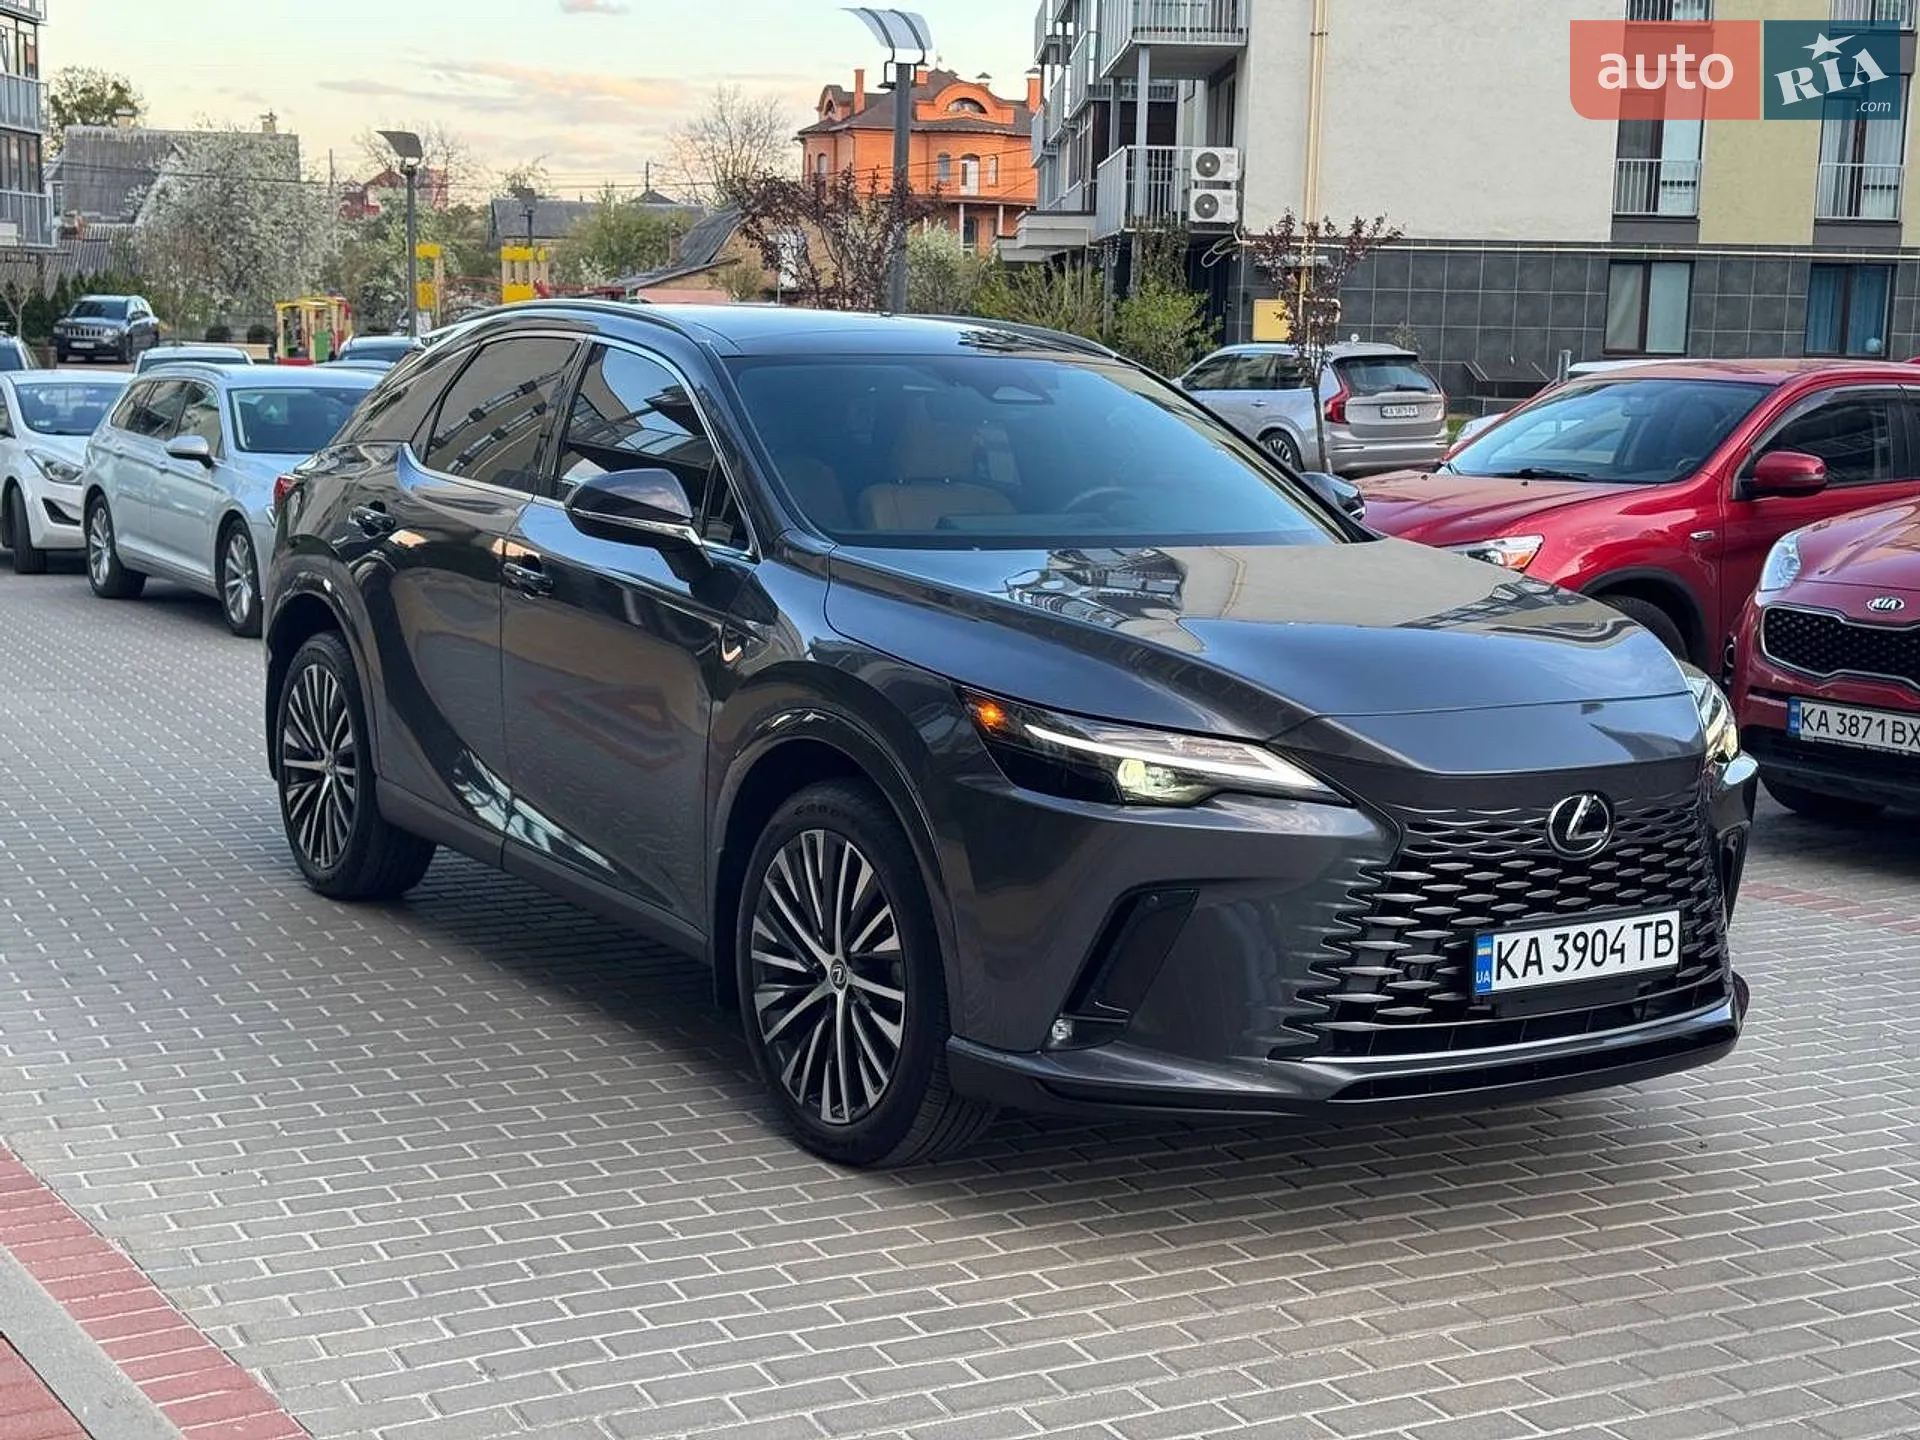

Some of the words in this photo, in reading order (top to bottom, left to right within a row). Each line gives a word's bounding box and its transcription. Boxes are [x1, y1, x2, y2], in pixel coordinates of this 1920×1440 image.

[1801, 707, 1830, 733] KA
[1836, 712, 1886, 742] 3871
[1891, 720, 1920, 747] BX
[1495, 936, 1544, 981] KA
[1552, 925, 1626, 973] 3904
[1633, 919, 1674, 961] TB
[1475, 970, 1491, 984] UA
